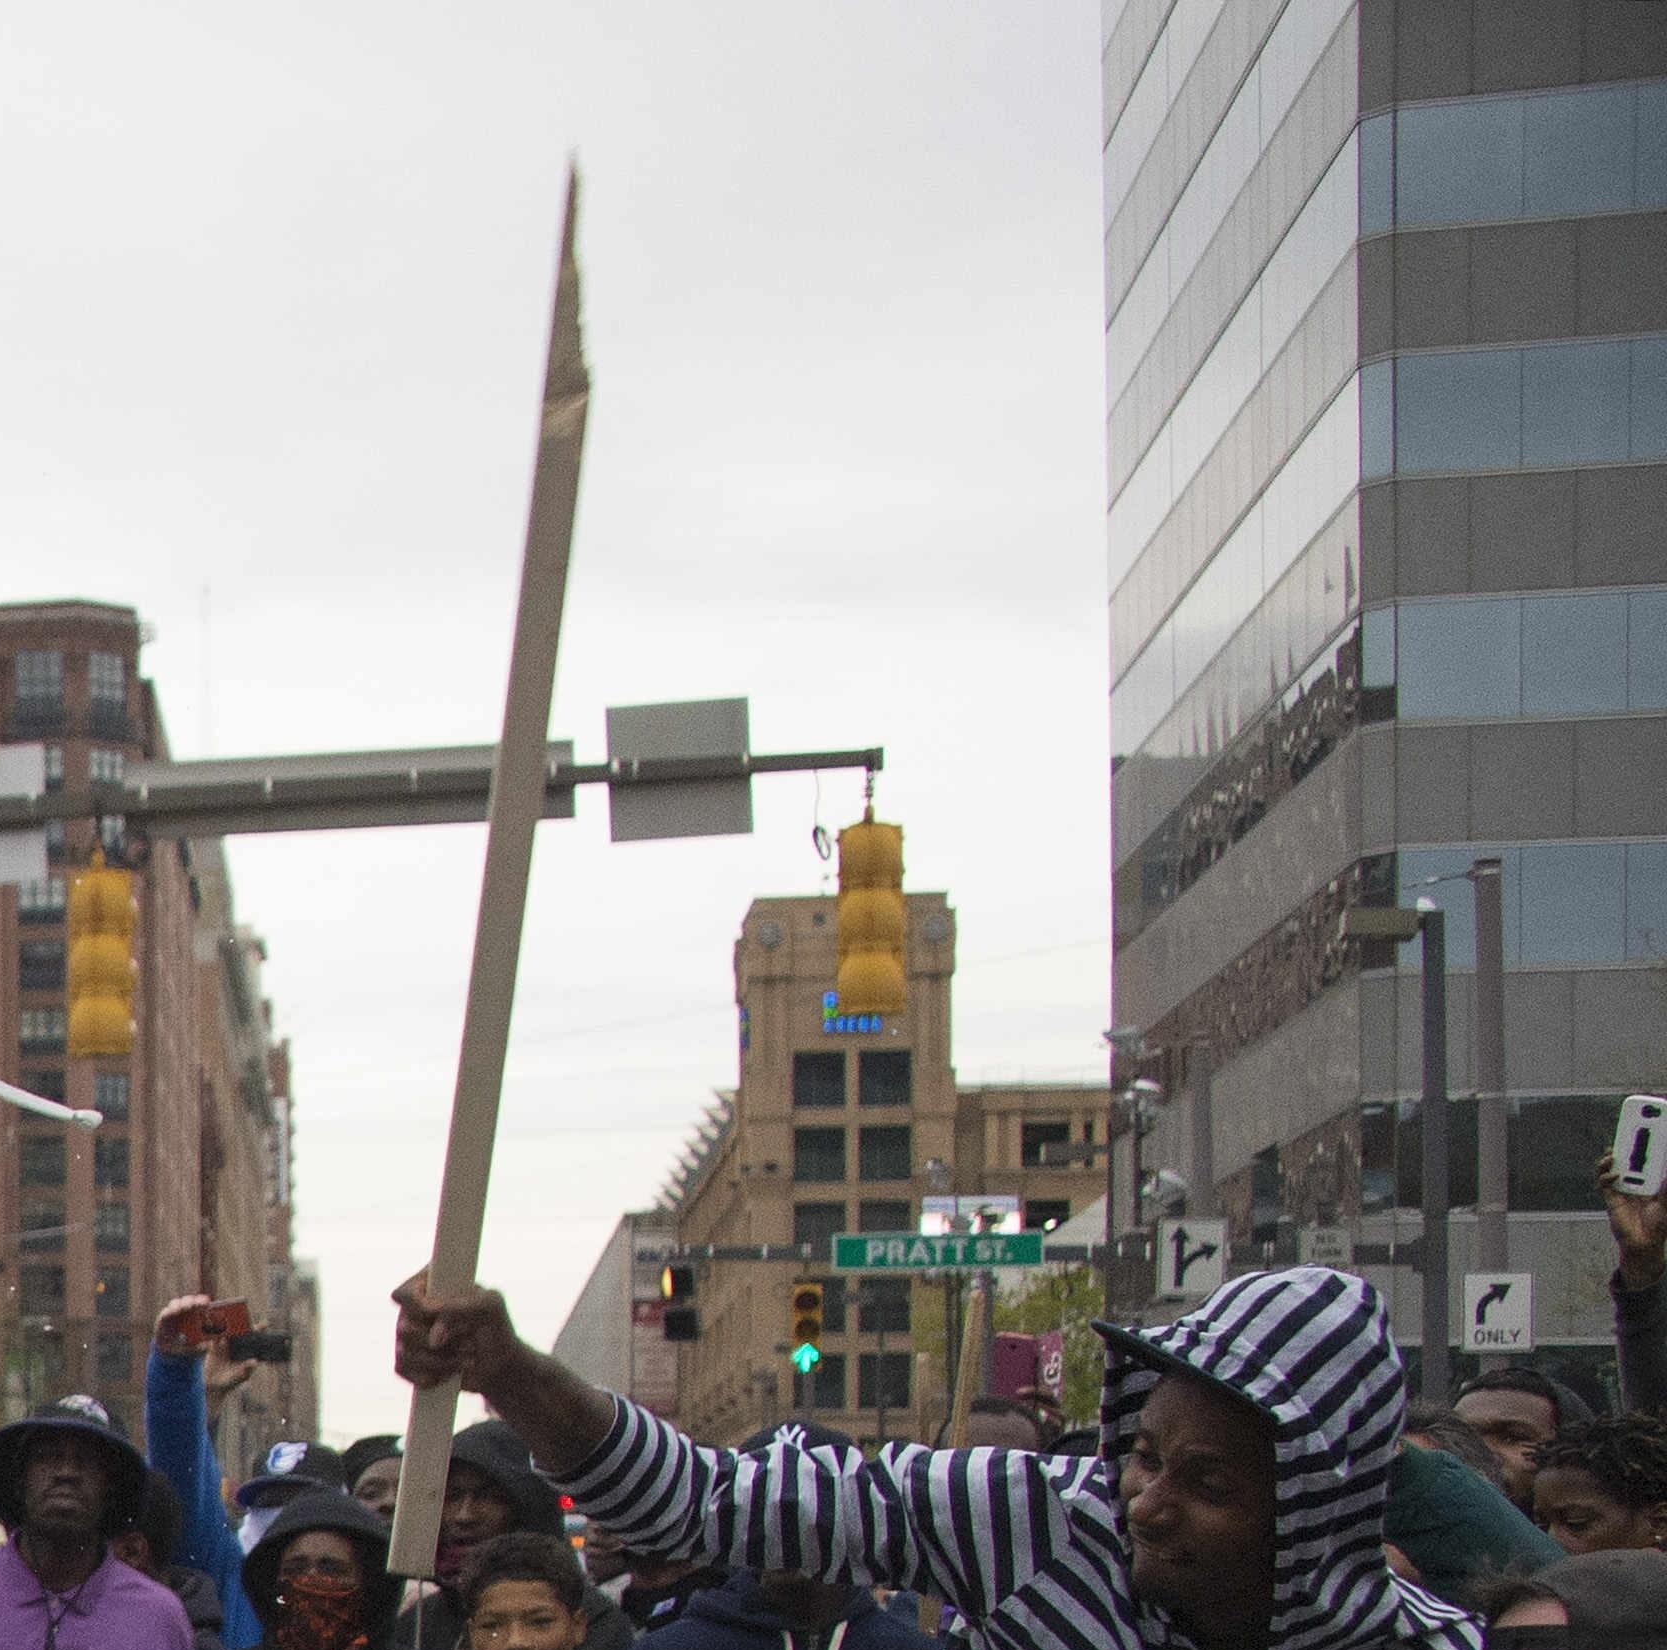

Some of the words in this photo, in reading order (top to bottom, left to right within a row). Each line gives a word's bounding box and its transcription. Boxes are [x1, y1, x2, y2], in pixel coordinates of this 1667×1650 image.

[867, 1239, 967, 1265] PRATT
[975, 1239, 1015, 1262] ST.
[1474, 1328, 1521, 1345] ONLY
